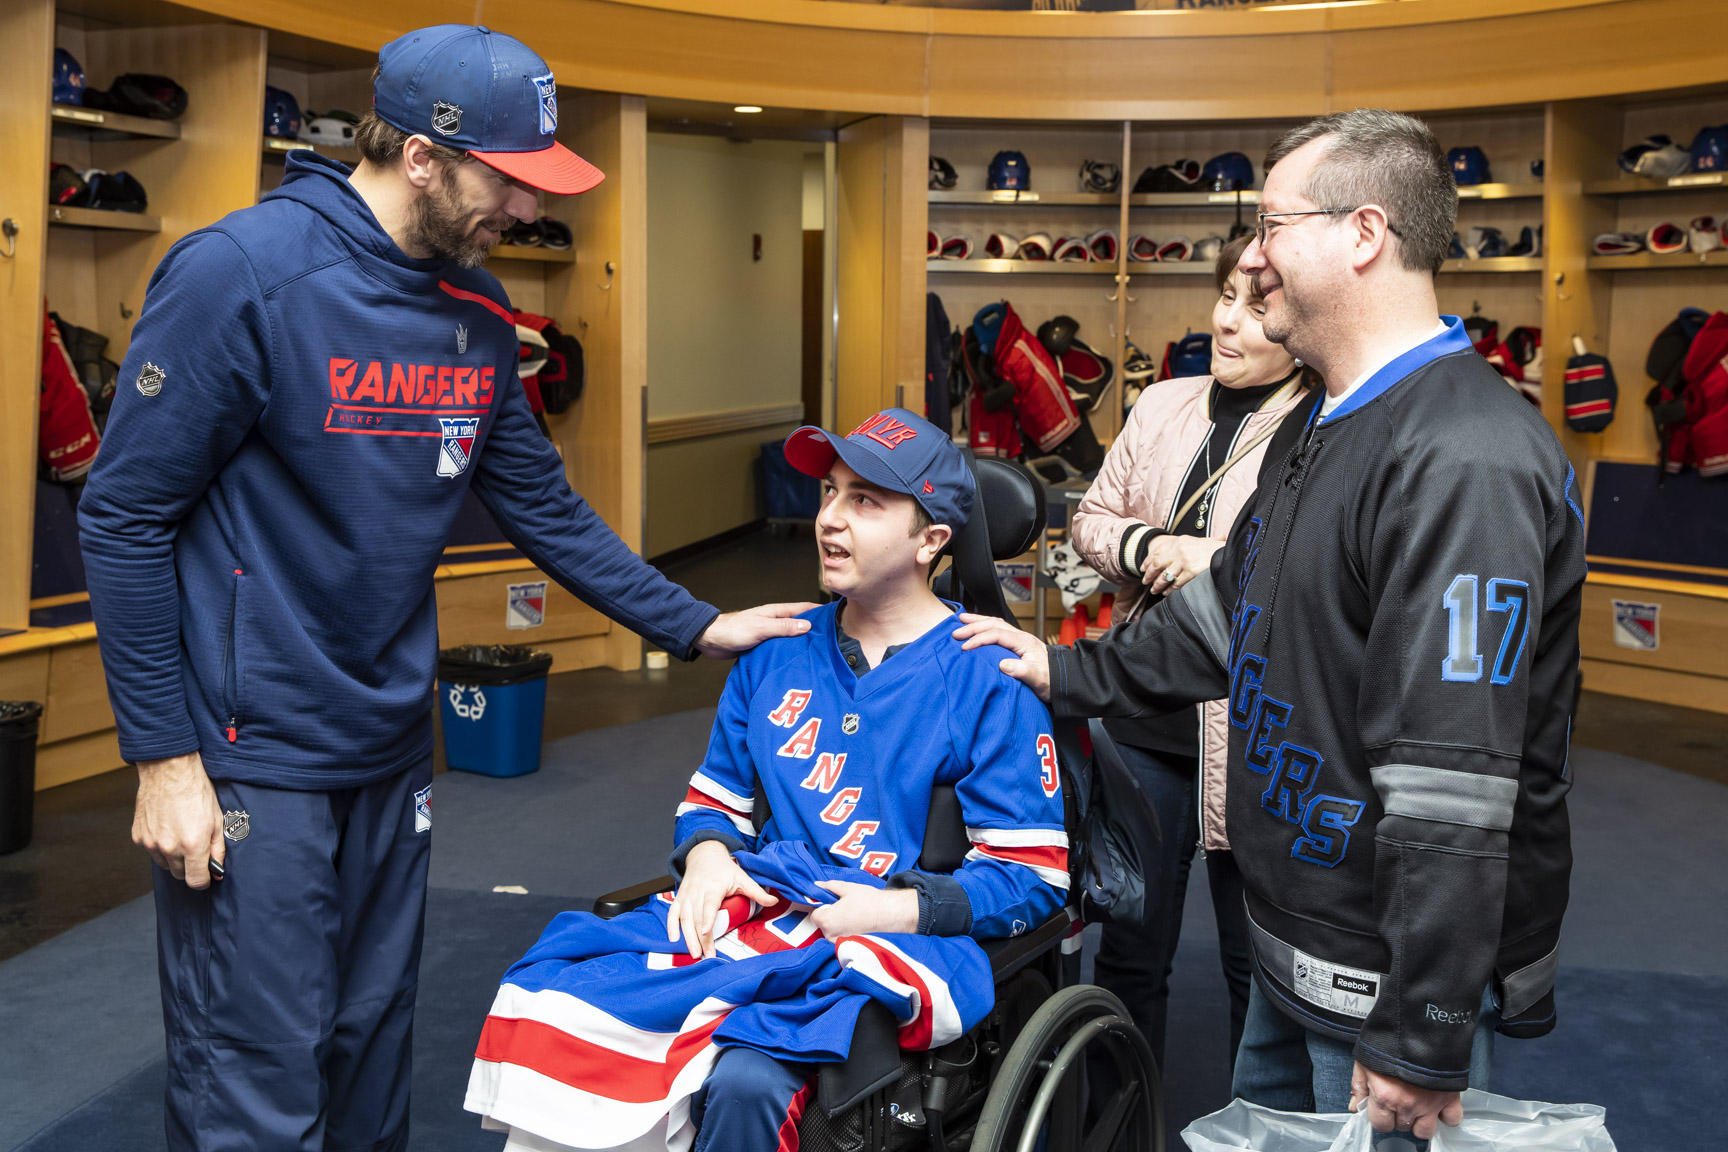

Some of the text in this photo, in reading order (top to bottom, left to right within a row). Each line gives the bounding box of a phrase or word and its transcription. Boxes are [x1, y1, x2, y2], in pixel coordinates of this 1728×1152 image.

[438, 112, 457, 125] NHL
[142, 375, 159, 386] NHL
[329, 357, 495, 405] RANGERS
[339, 413, 383, 425] HOCKEY
[444, 425, 475, 436] NEW YORK
[851, 413, 918, 446] NYR
[447, 439, 468, 470] RANGERS
[1441, 573, 1530, 686] 17
[1036, 733, 1060, 798] 3
[229, 818, 245, 834] NHL
[1337, 977, 1369, 992] Reebok
[1343, 994, 1359, 1009] M
